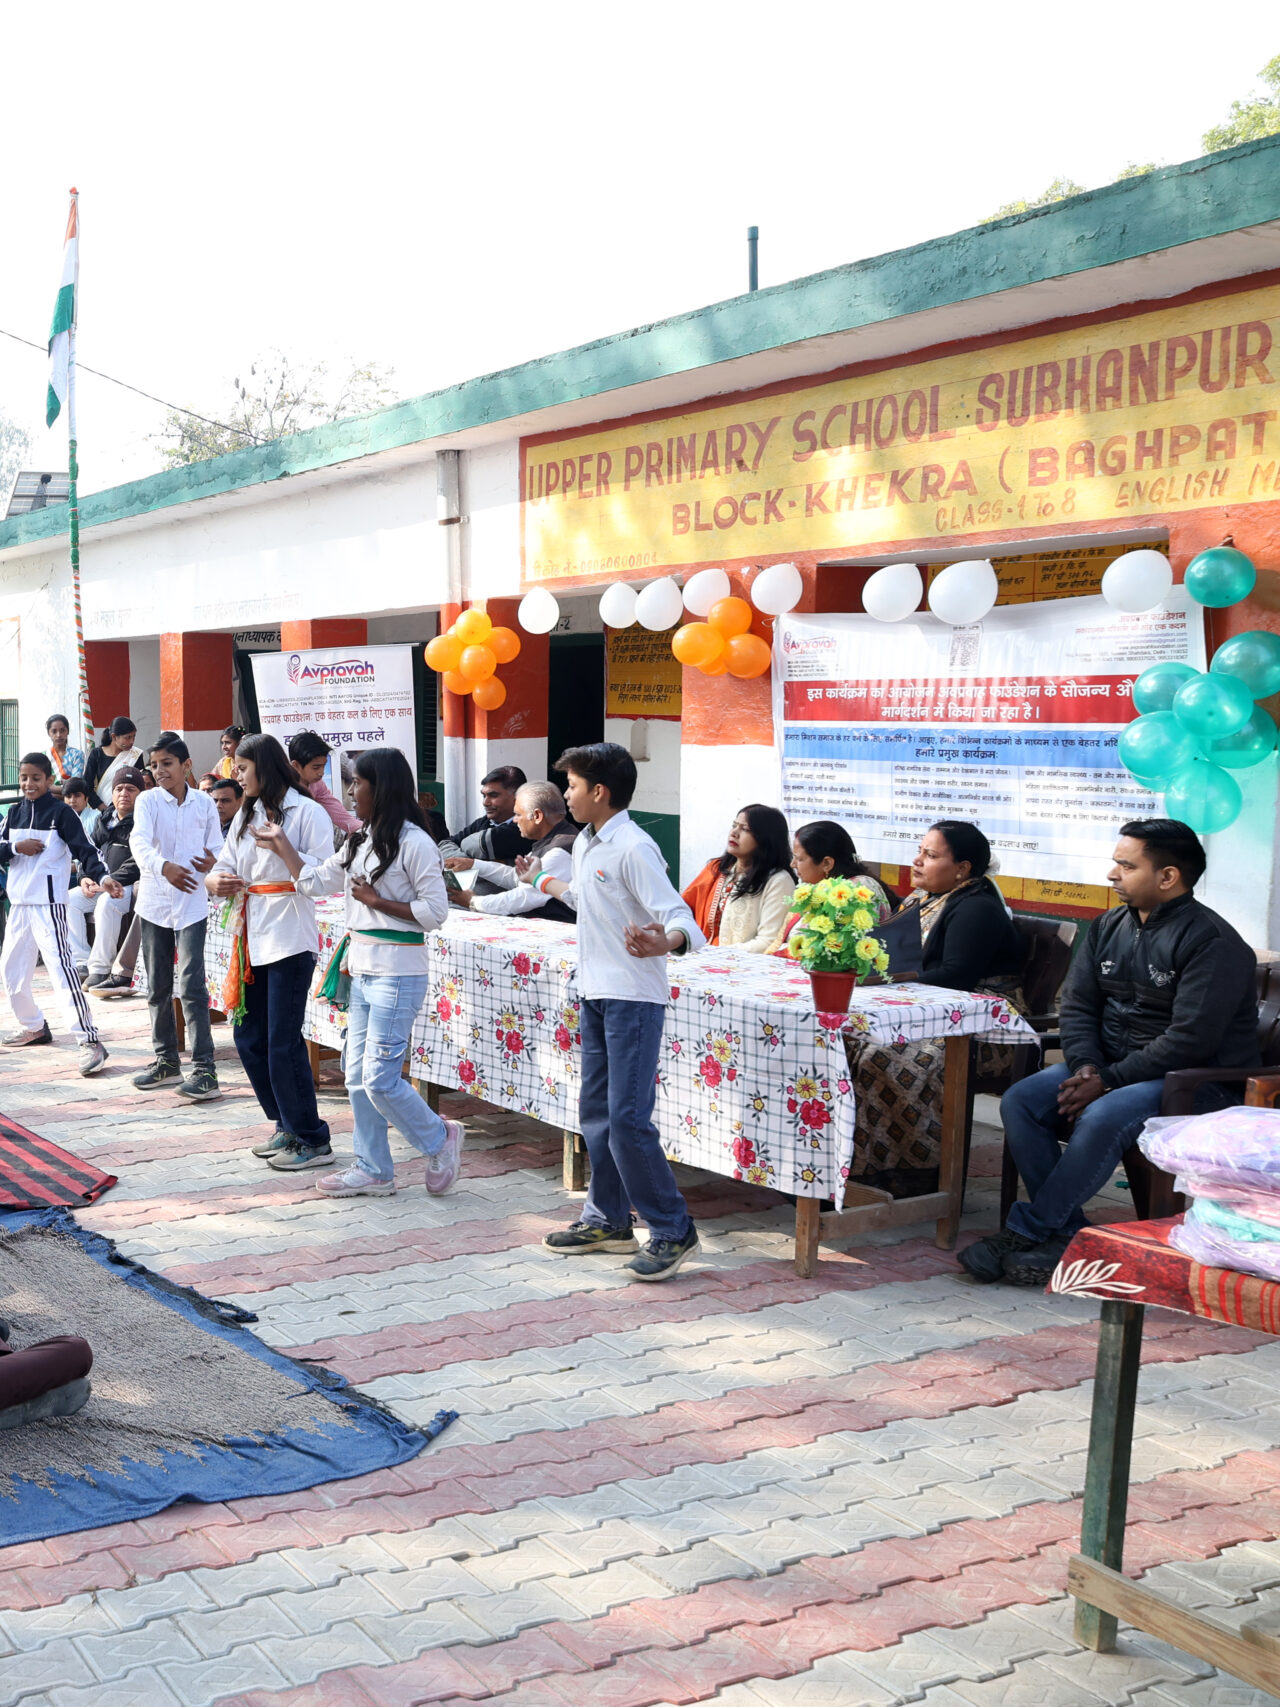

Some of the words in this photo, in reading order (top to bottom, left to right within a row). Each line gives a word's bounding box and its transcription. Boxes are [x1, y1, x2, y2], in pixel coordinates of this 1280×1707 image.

[528, 451, 612, 507] UPPER
[623, 415, 784, 492] PRIMARY
[791, 384, 956, 463] SCHOOL
[975, 320, 1276, 433] SUBHANPUR
[1061, 487, 1077, 515] 8
[1115, 466, 1230, 508] ENGLISH
[300, 660, 375, 685] Avpravah
[324, 675, 375, 686] FOUNDATION
[807, 687, 823, 701] इस
[825, 683, 867, 699] कार्यक्रम
[870, 687, 885, 698] का
[888, 683, 935, 699] आयोजन
[1044, 680, 1058, 697] के
[1060, 679, 1111, 698] सौजन्य
[1116, 678, 1134, 697] औ
[314, 711, 325, 723] एक
[347, 709, 359, 720] कल
[361, 706, 368, 719] के
[369, 706, 382, 719] लिए
[384, 708, 396, 719] एक
[880, 701, 929, 718] मार्गदर्शन
[933, 701, 945, 717] में
[948, 702, 976, 718] किया
[981, 706, 996, 717] जा
[999, 706, 1019, 718] रहा
[322, 731, 352, 747] प्रमुख
[357, 726, 385, 742] पहलें
[1061, 738, 1075, 748] एक
[915, 745, 935, 758] हमारे
[938, 749, 959, 761] प्रमुख
